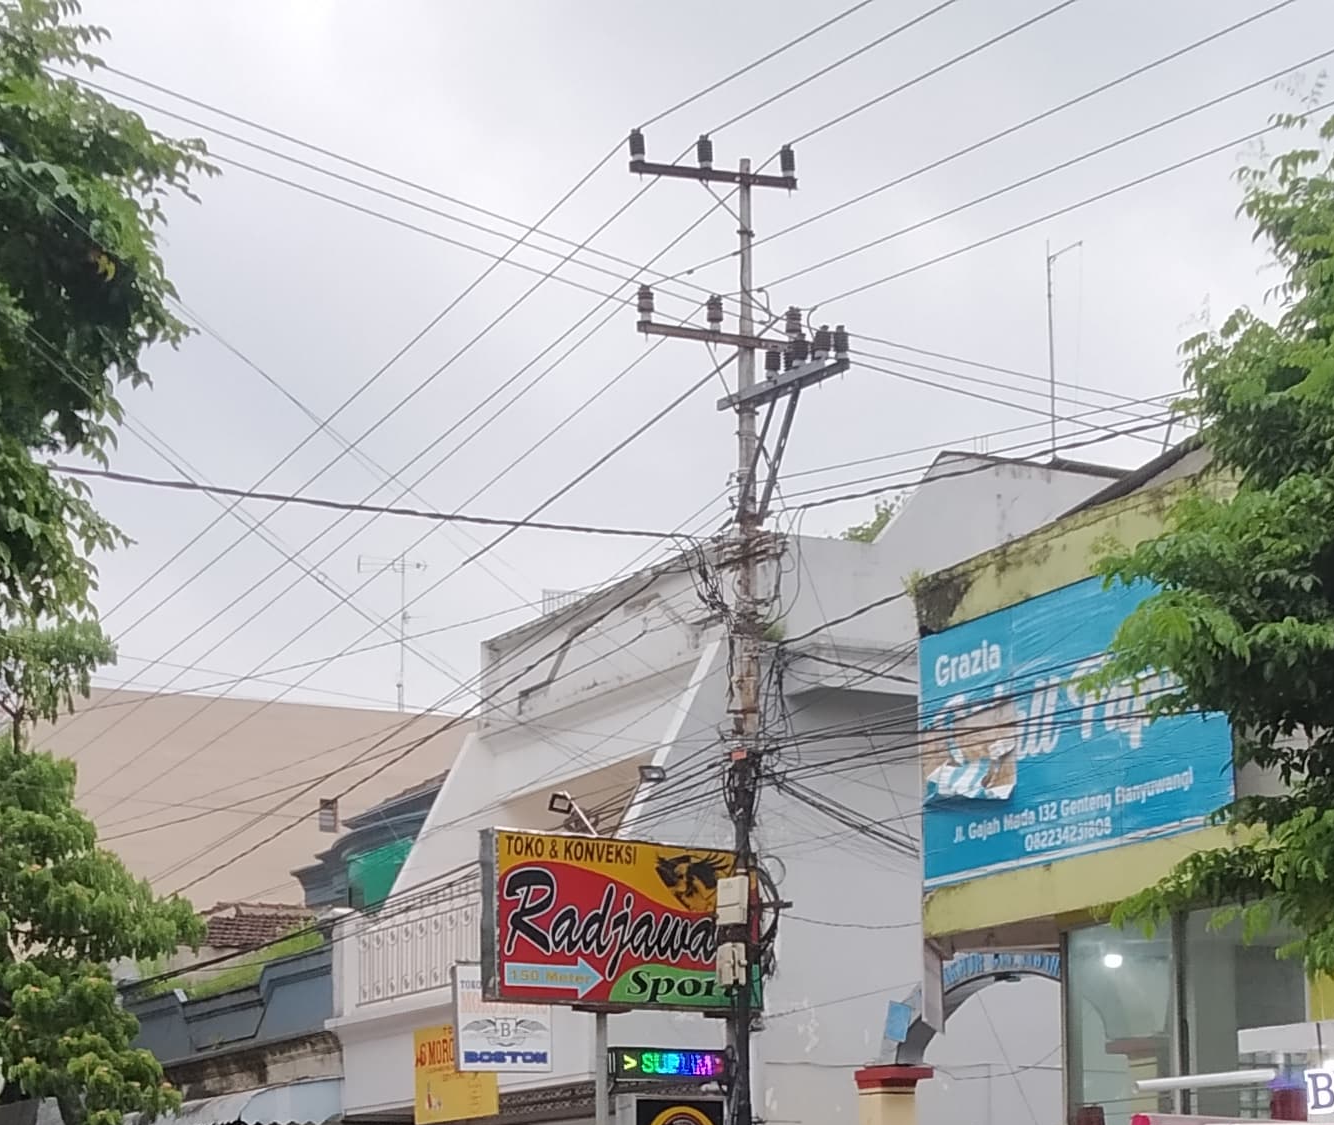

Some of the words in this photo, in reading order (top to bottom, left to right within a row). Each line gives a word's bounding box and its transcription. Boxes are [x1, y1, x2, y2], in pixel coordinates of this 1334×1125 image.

[934, 640, 1001, 688] Grazia
[968, 818, 1001, 841] Gajah
[1003, 809, 1036, 832] Mada
[1038, 801, 1058, 822] 132
[1060, 792, 1112, 818] Genteng
[1114, 766, 1194, 805] Banyuwangi
[506, 835, 544, 858] TOKO
[549, 843, 559, 859] &
[564, 841, 638, 866] KONVEKSI
[503, 865, 718, 983] Radjawa
[463, 1050, 549, 1064] BOSTON
